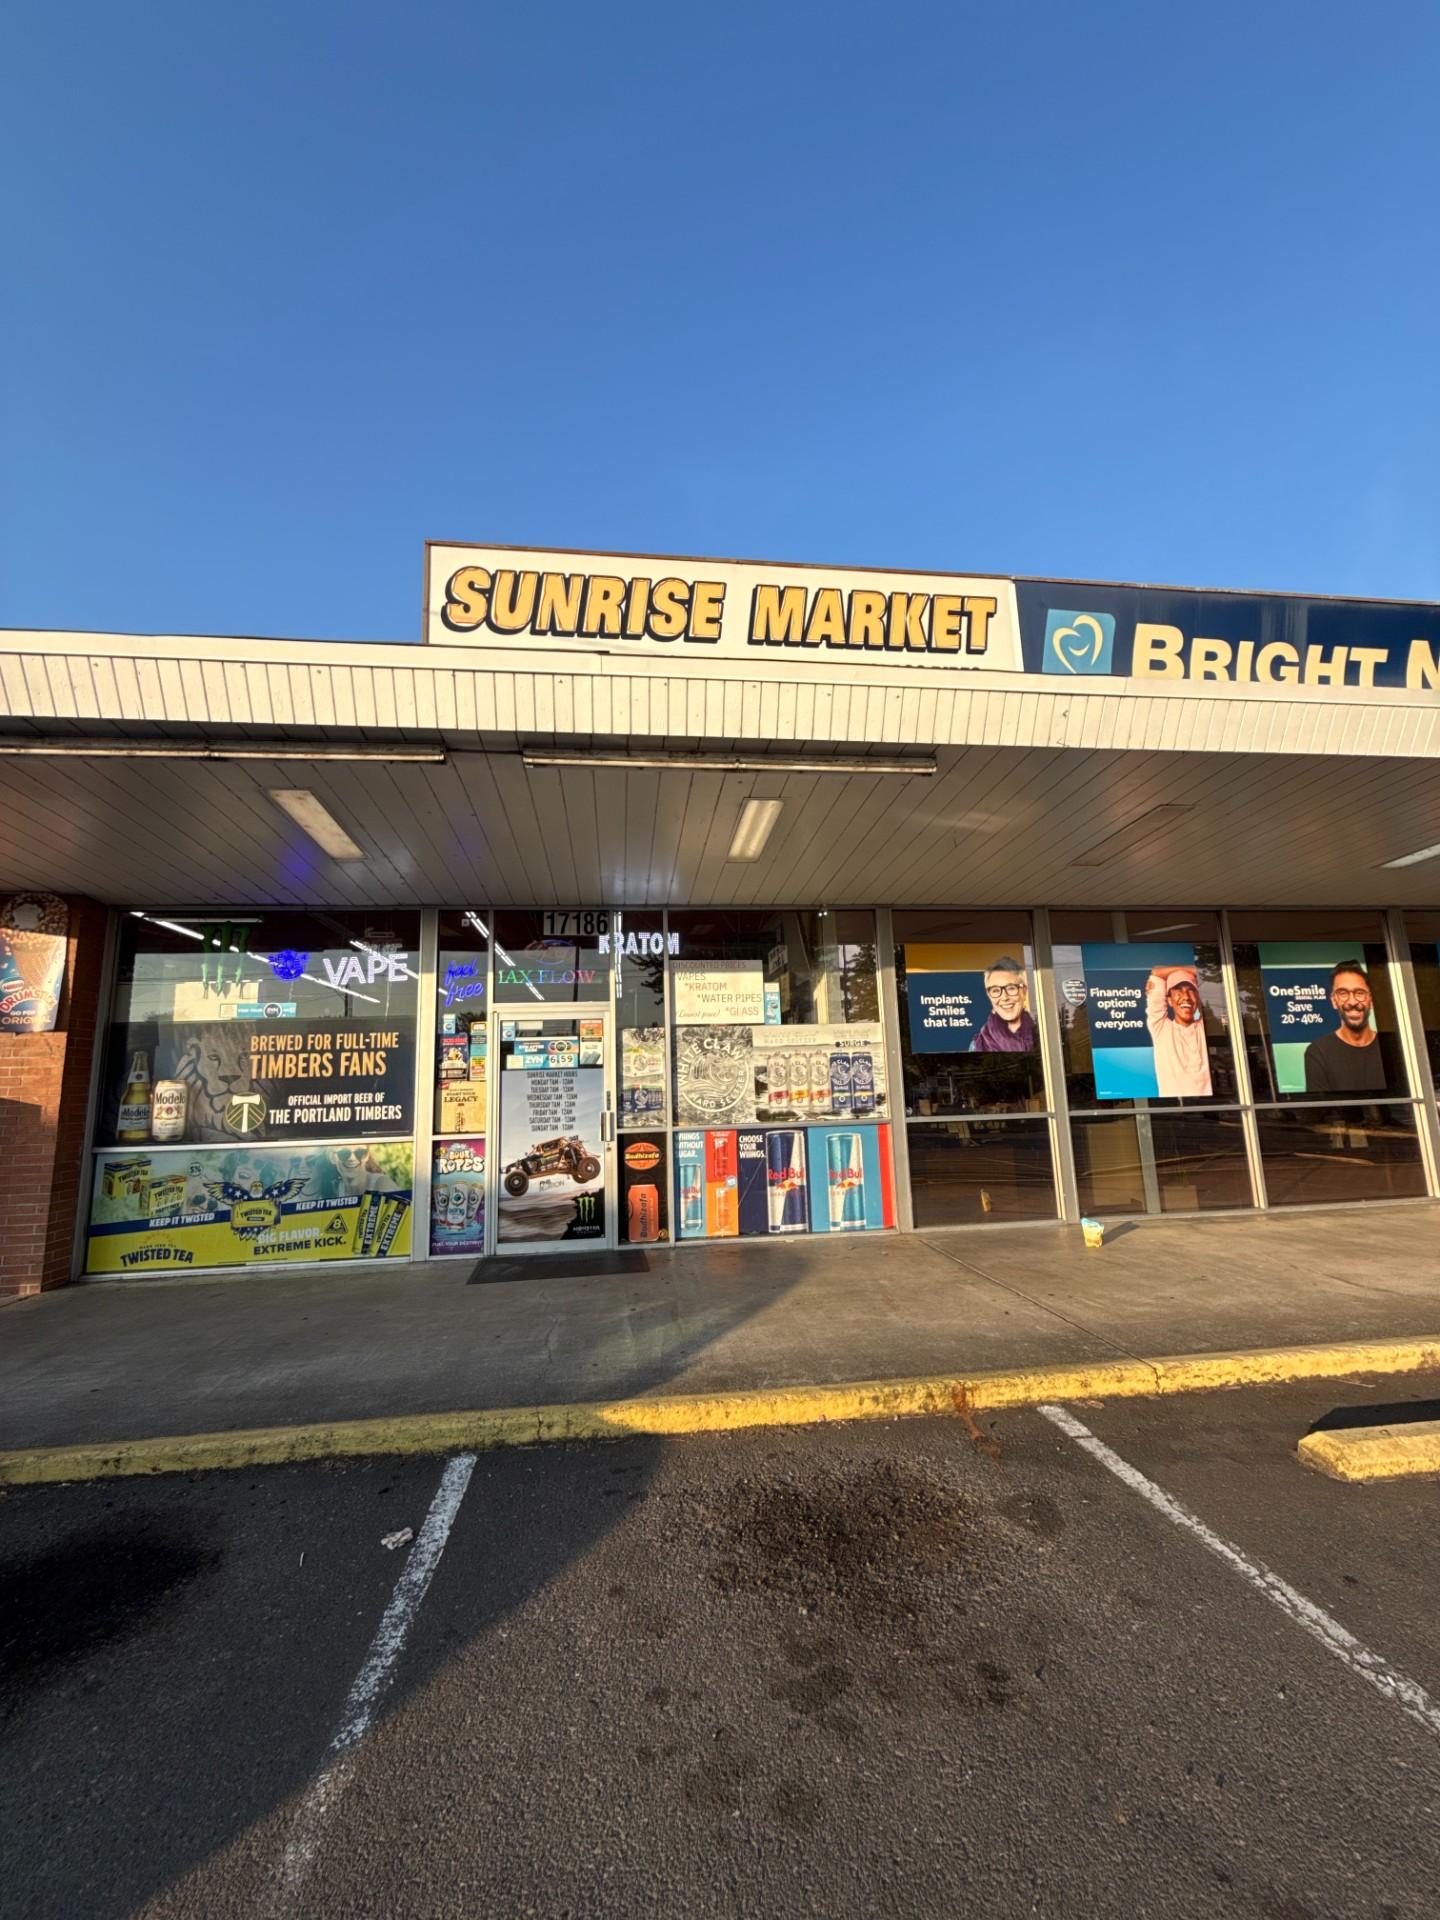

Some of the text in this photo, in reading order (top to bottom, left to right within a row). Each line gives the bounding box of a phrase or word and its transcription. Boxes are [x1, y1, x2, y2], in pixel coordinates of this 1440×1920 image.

[441, 566, 998, 654] SUNRISE MARKET
[546, 912, 608, 936] 17186
[322, 953, 409, 986] VAPE
[1089, 987, 1142, 999] Financing
[1269, 984, 1326, 997] OneSmile
[920, 994, 973, 1007] Implants.
[1097, 998, 1137, 1010] options
[1286, 1001, 1313, 1012] Save
[928, 1005, 966, 1016] Smiles
[1110, 1009, 1126, 1019] for
[923, 1016, 973, 1028] that last.
[1094, 1020, 1144, 1031] everyone
[250, 1031, 400, 1052] BREWED FOR FULL-TIME
[703, 1038, 744, 1061] CLAW
[250, 1051, 387, 1079] TIMBERS FANS
[287, 1092, 385, 1106] OFFICIAL IMPORT BEER OF
[443, 1095, 479, 1103] LEGACY
[269, 1105, 403, 1125] THE PORTLAND TIMBERS
[739, 1135, 764, 1144] CHOOSE
[739, 1143, 757, 1151] YOUR
[768, 1168, 787, 1179] Red
[295, 1196, 359, 1211] KEEP IT TWISTED
[148, 1212, 216, 1228] KEEP IT TWISTED
[253, 1235, 347, 1255] EXTREME KICK.
[120, 1249, 195, 1267] TWISTED TEA
